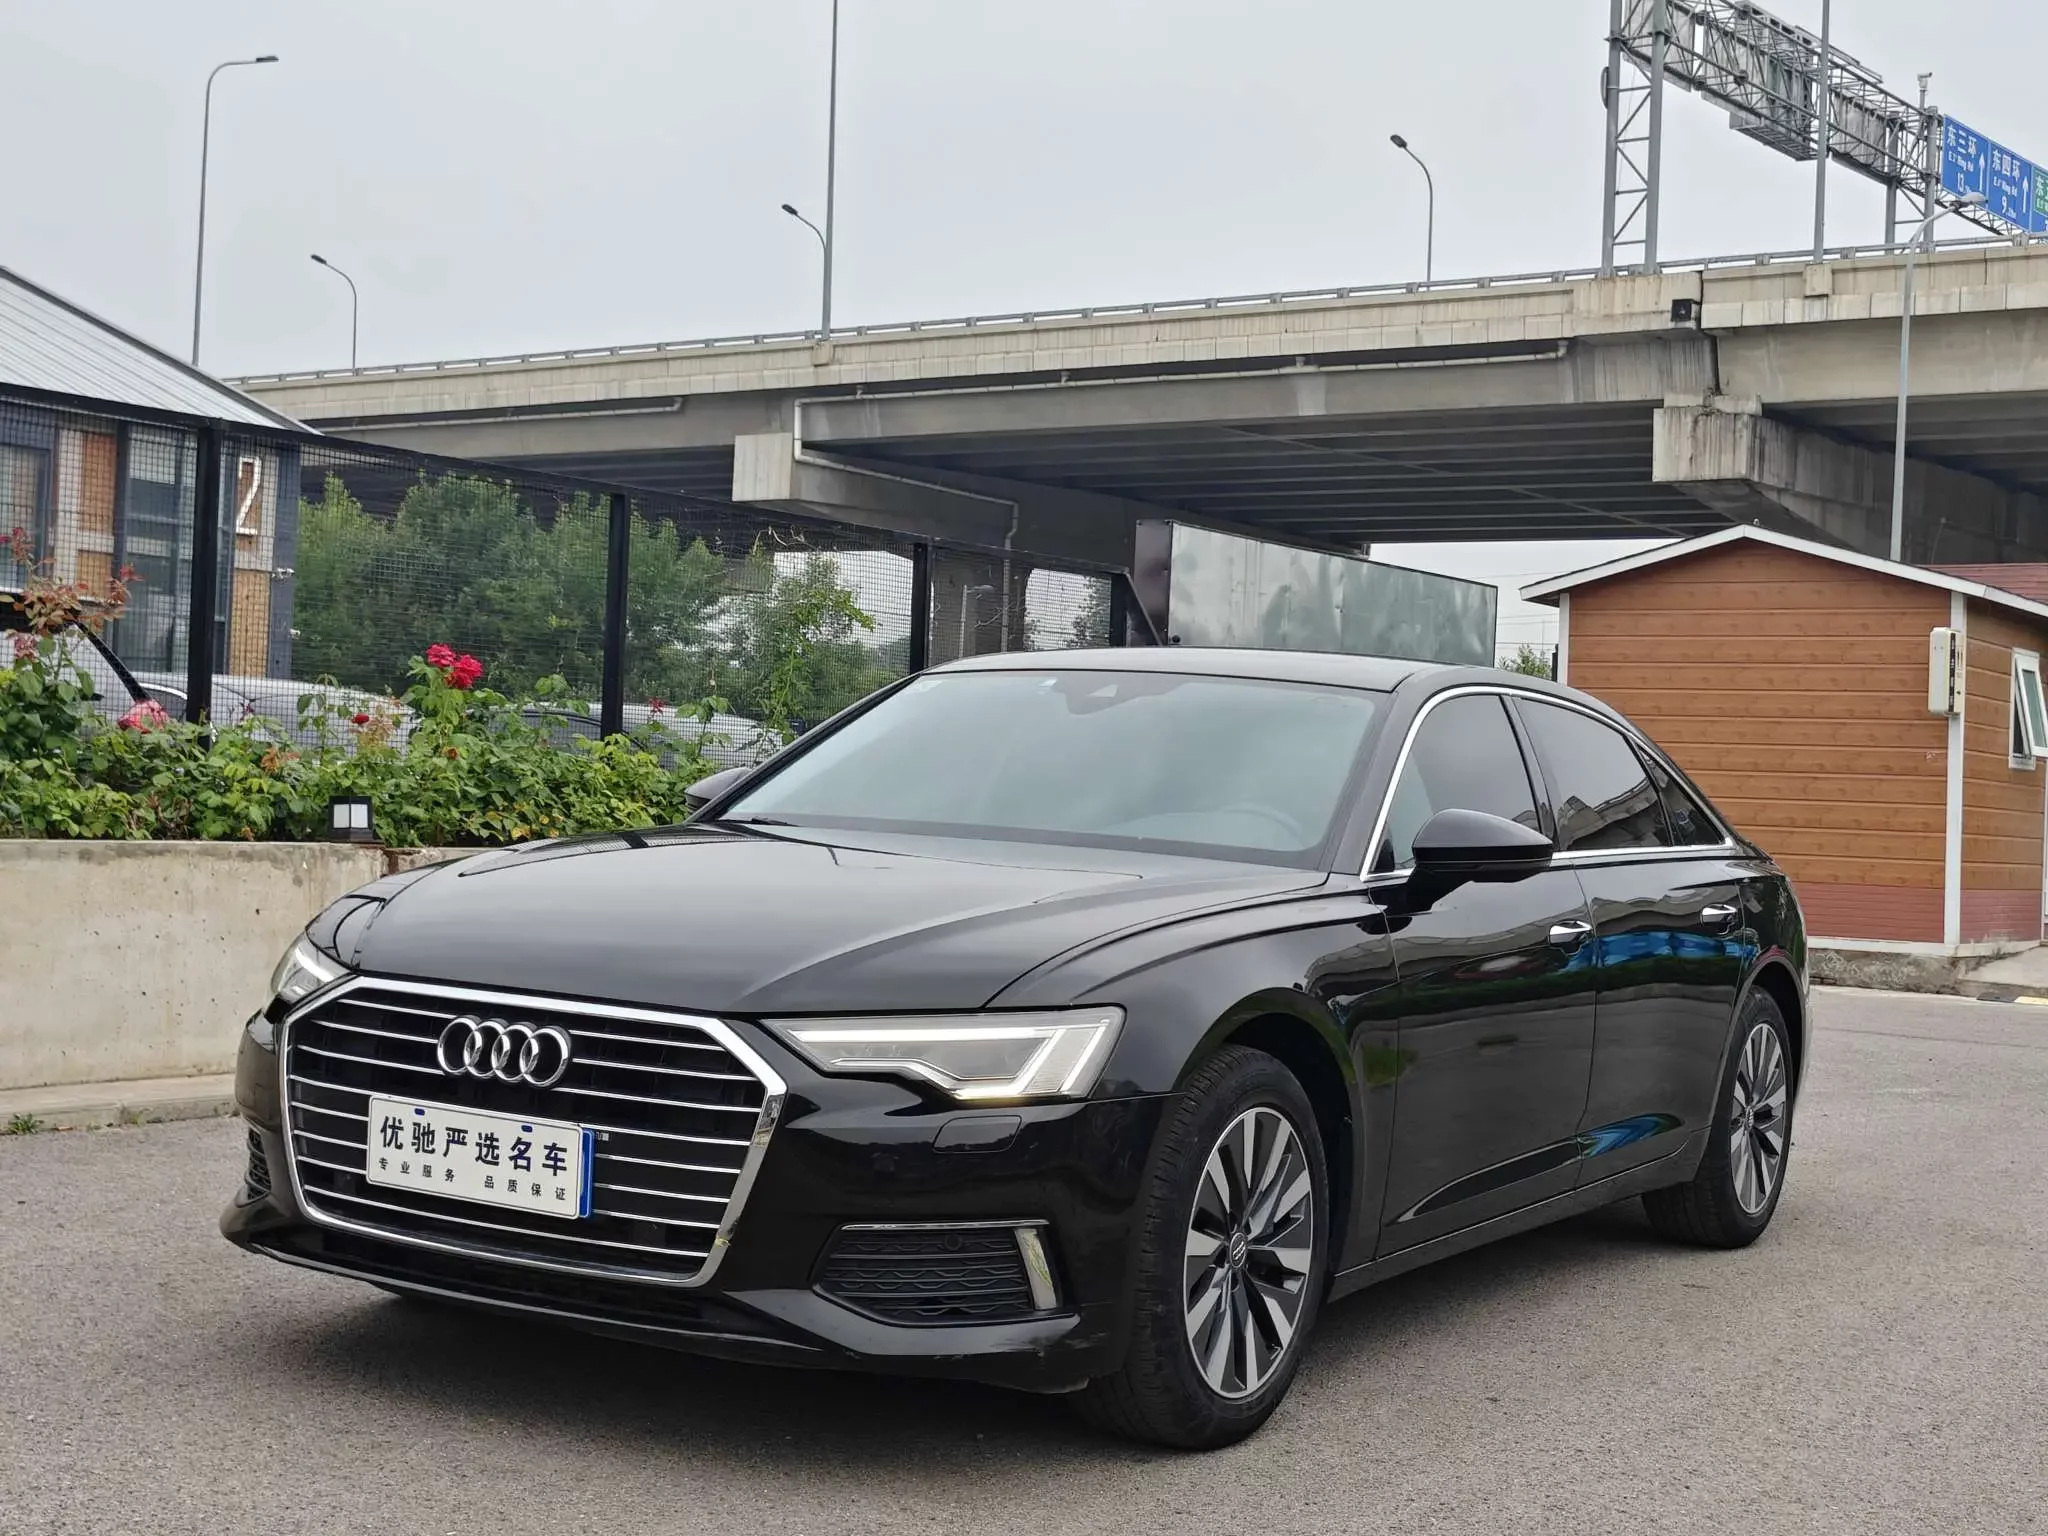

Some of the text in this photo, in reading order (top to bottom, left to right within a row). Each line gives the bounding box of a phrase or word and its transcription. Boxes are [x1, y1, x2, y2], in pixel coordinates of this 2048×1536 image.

[1947, 124, 1977, 158] 东三环
[1992, 149, 2021, 182] 东四环
[236, 456, 262, 535] 2
[379, 1115, 568, 1177] 优驰严选名车
[378, 1157, 566, 1201] 专业服务 品质保证
